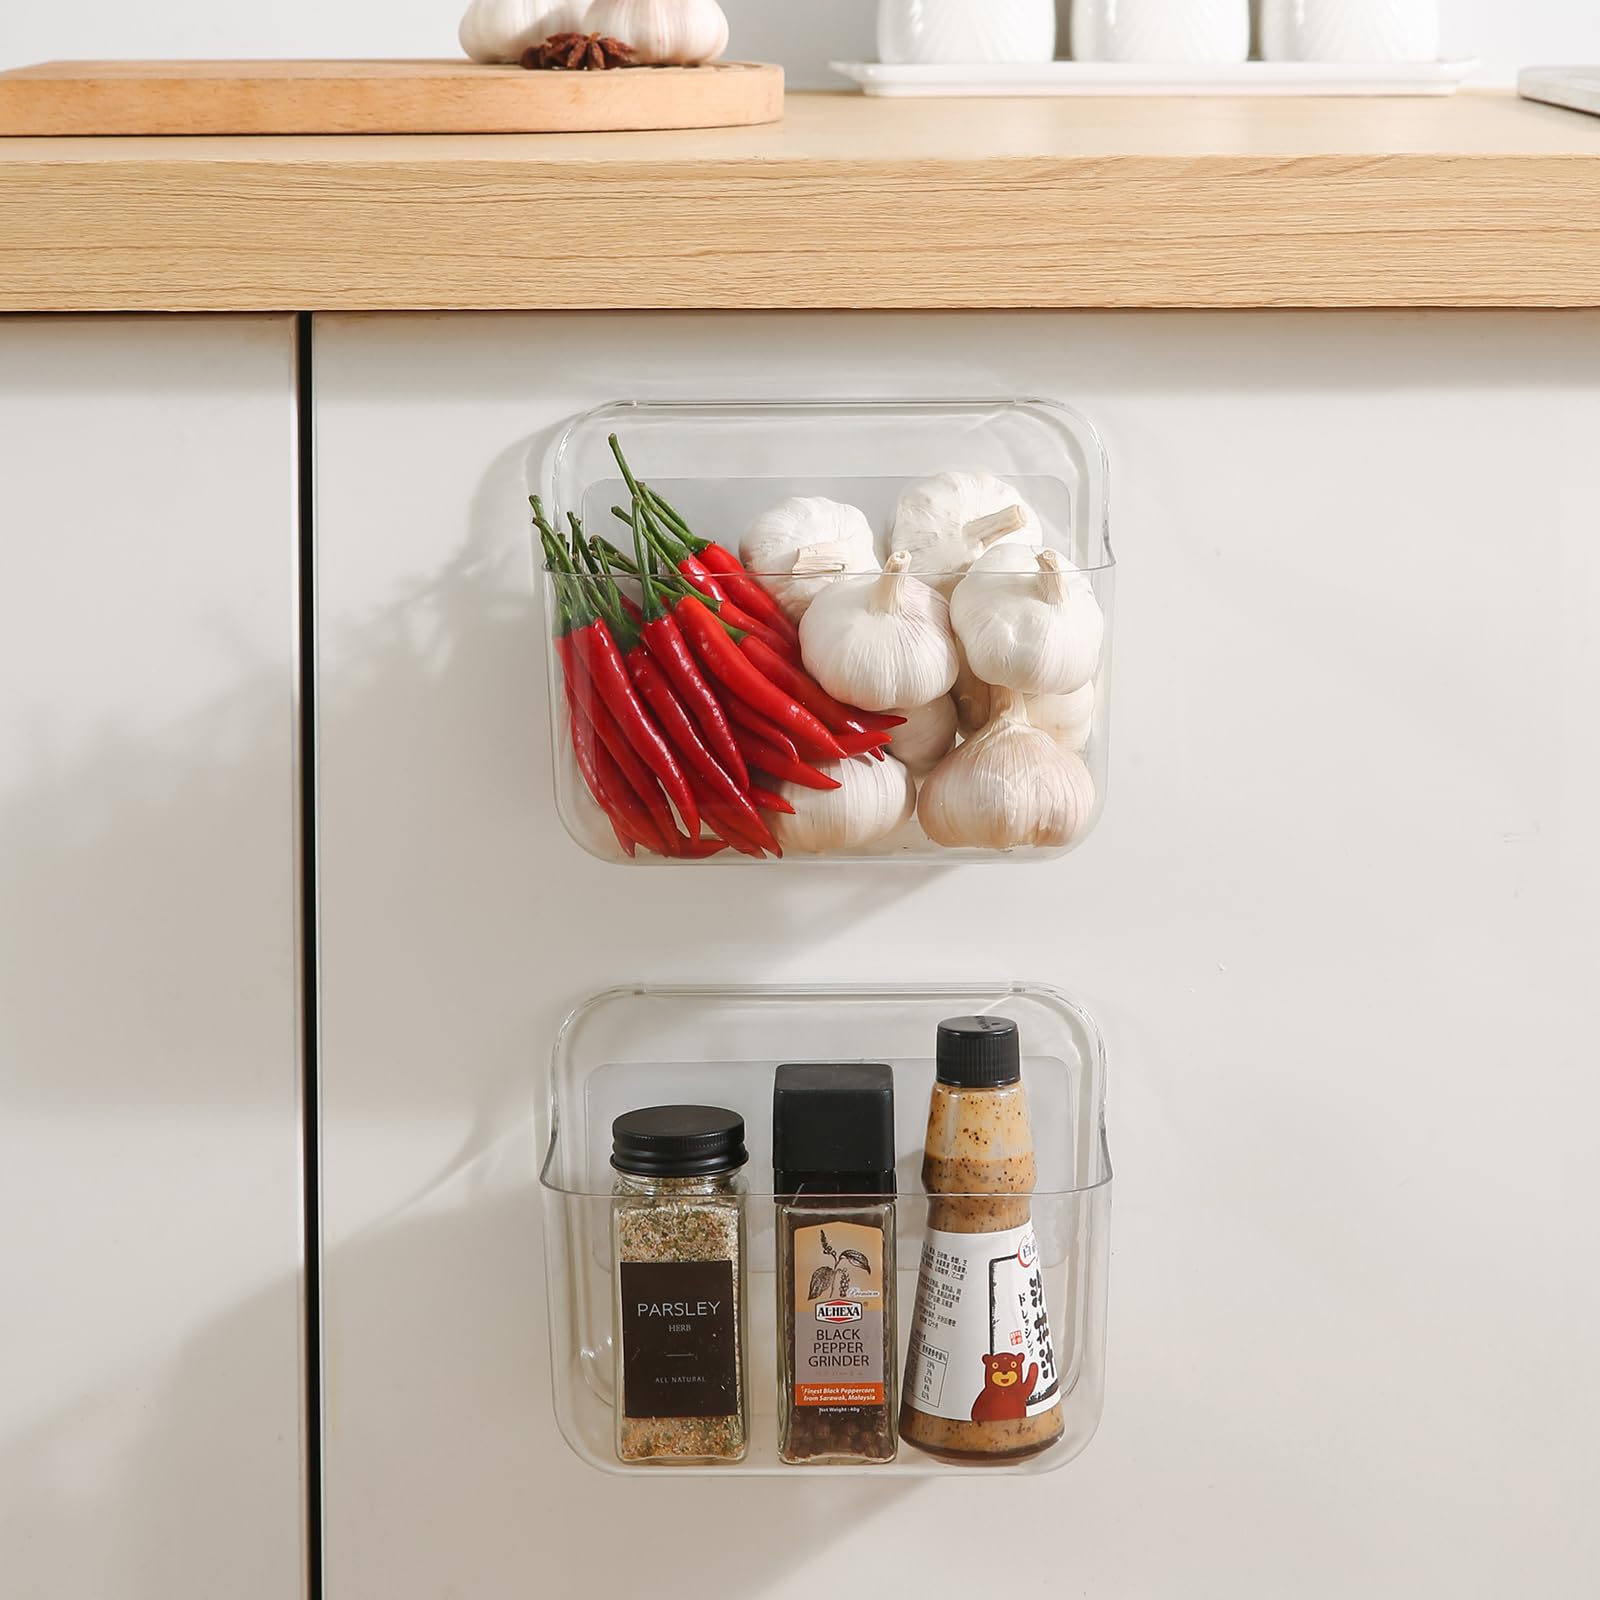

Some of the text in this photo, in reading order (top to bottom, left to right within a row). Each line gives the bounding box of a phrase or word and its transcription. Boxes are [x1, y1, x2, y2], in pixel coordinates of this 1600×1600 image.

[637, 1301, 721, 1317] PARSLEY
[668, 1324, 692, 1333] HERB
[816, 1328, 861, 1341] BLACK
[813, 1342, 864, 1354] PEPPER
[808, 1355, 870, 1367] GRINDER
[841, 1387, 876, 1395] Peppercorn
